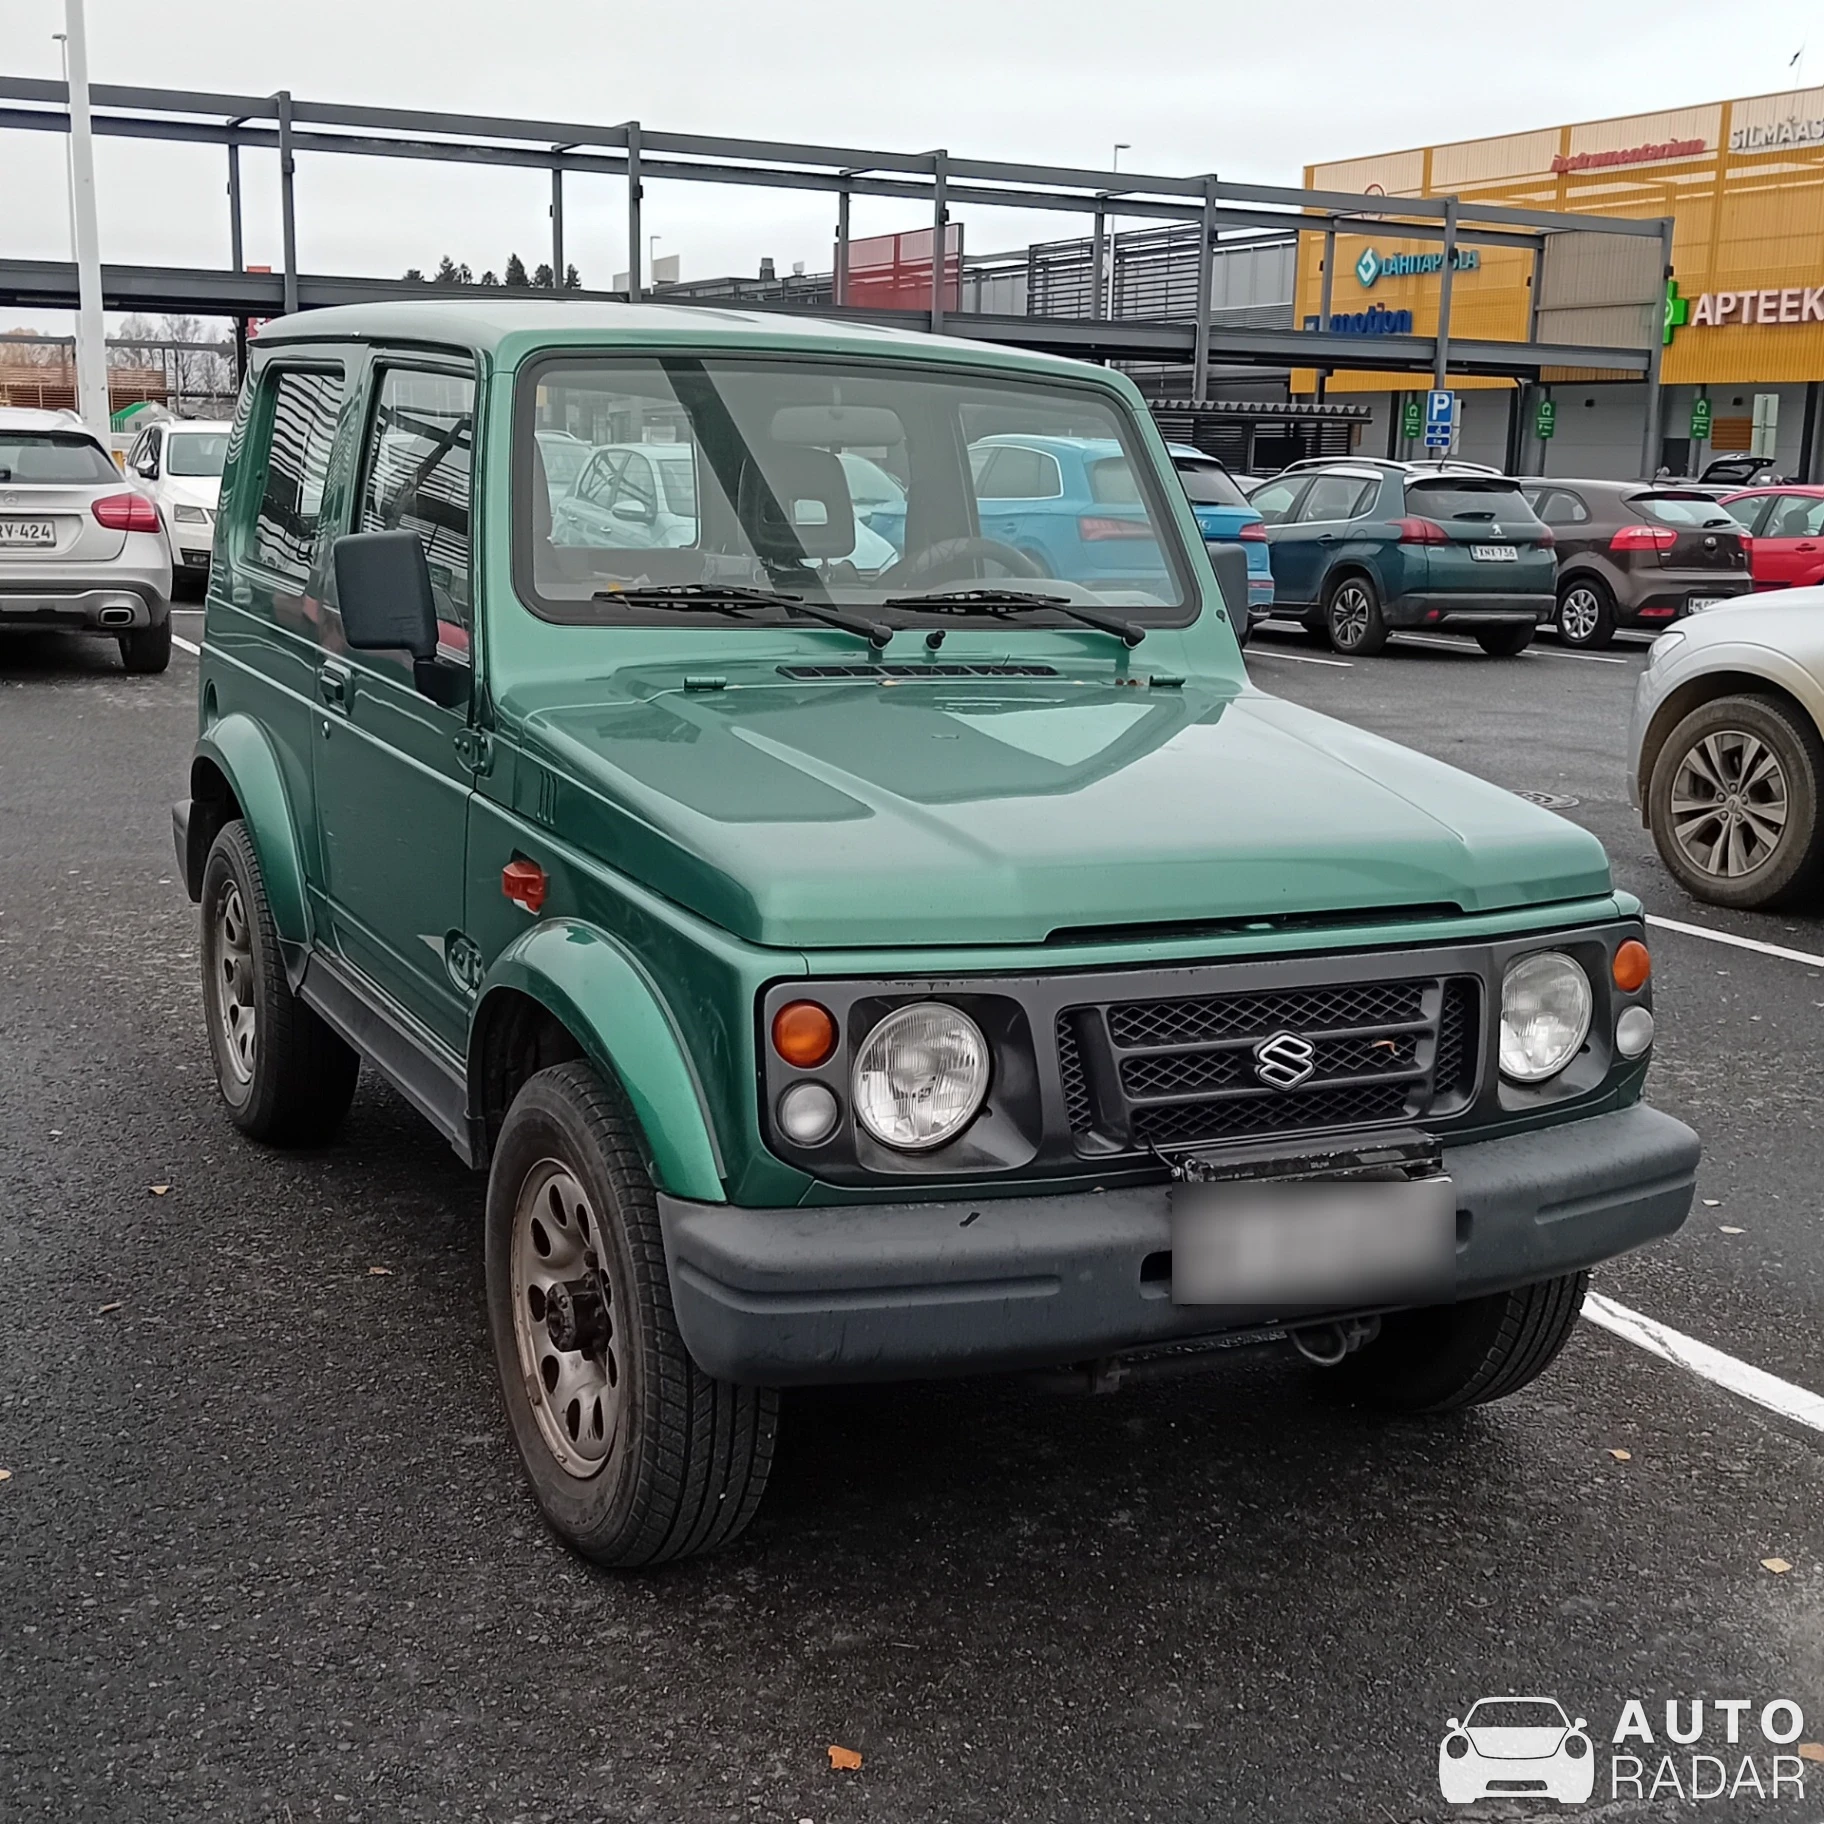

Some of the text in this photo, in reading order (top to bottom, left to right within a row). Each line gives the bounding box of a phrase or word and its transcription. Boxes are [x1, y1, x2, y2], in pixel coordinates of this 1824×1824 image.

[1380, 250, 1480, 276] LÄHITAPLA
[1690, 285, 1824, 327] APTEEK
[1432, 393, 1450, 420] P
